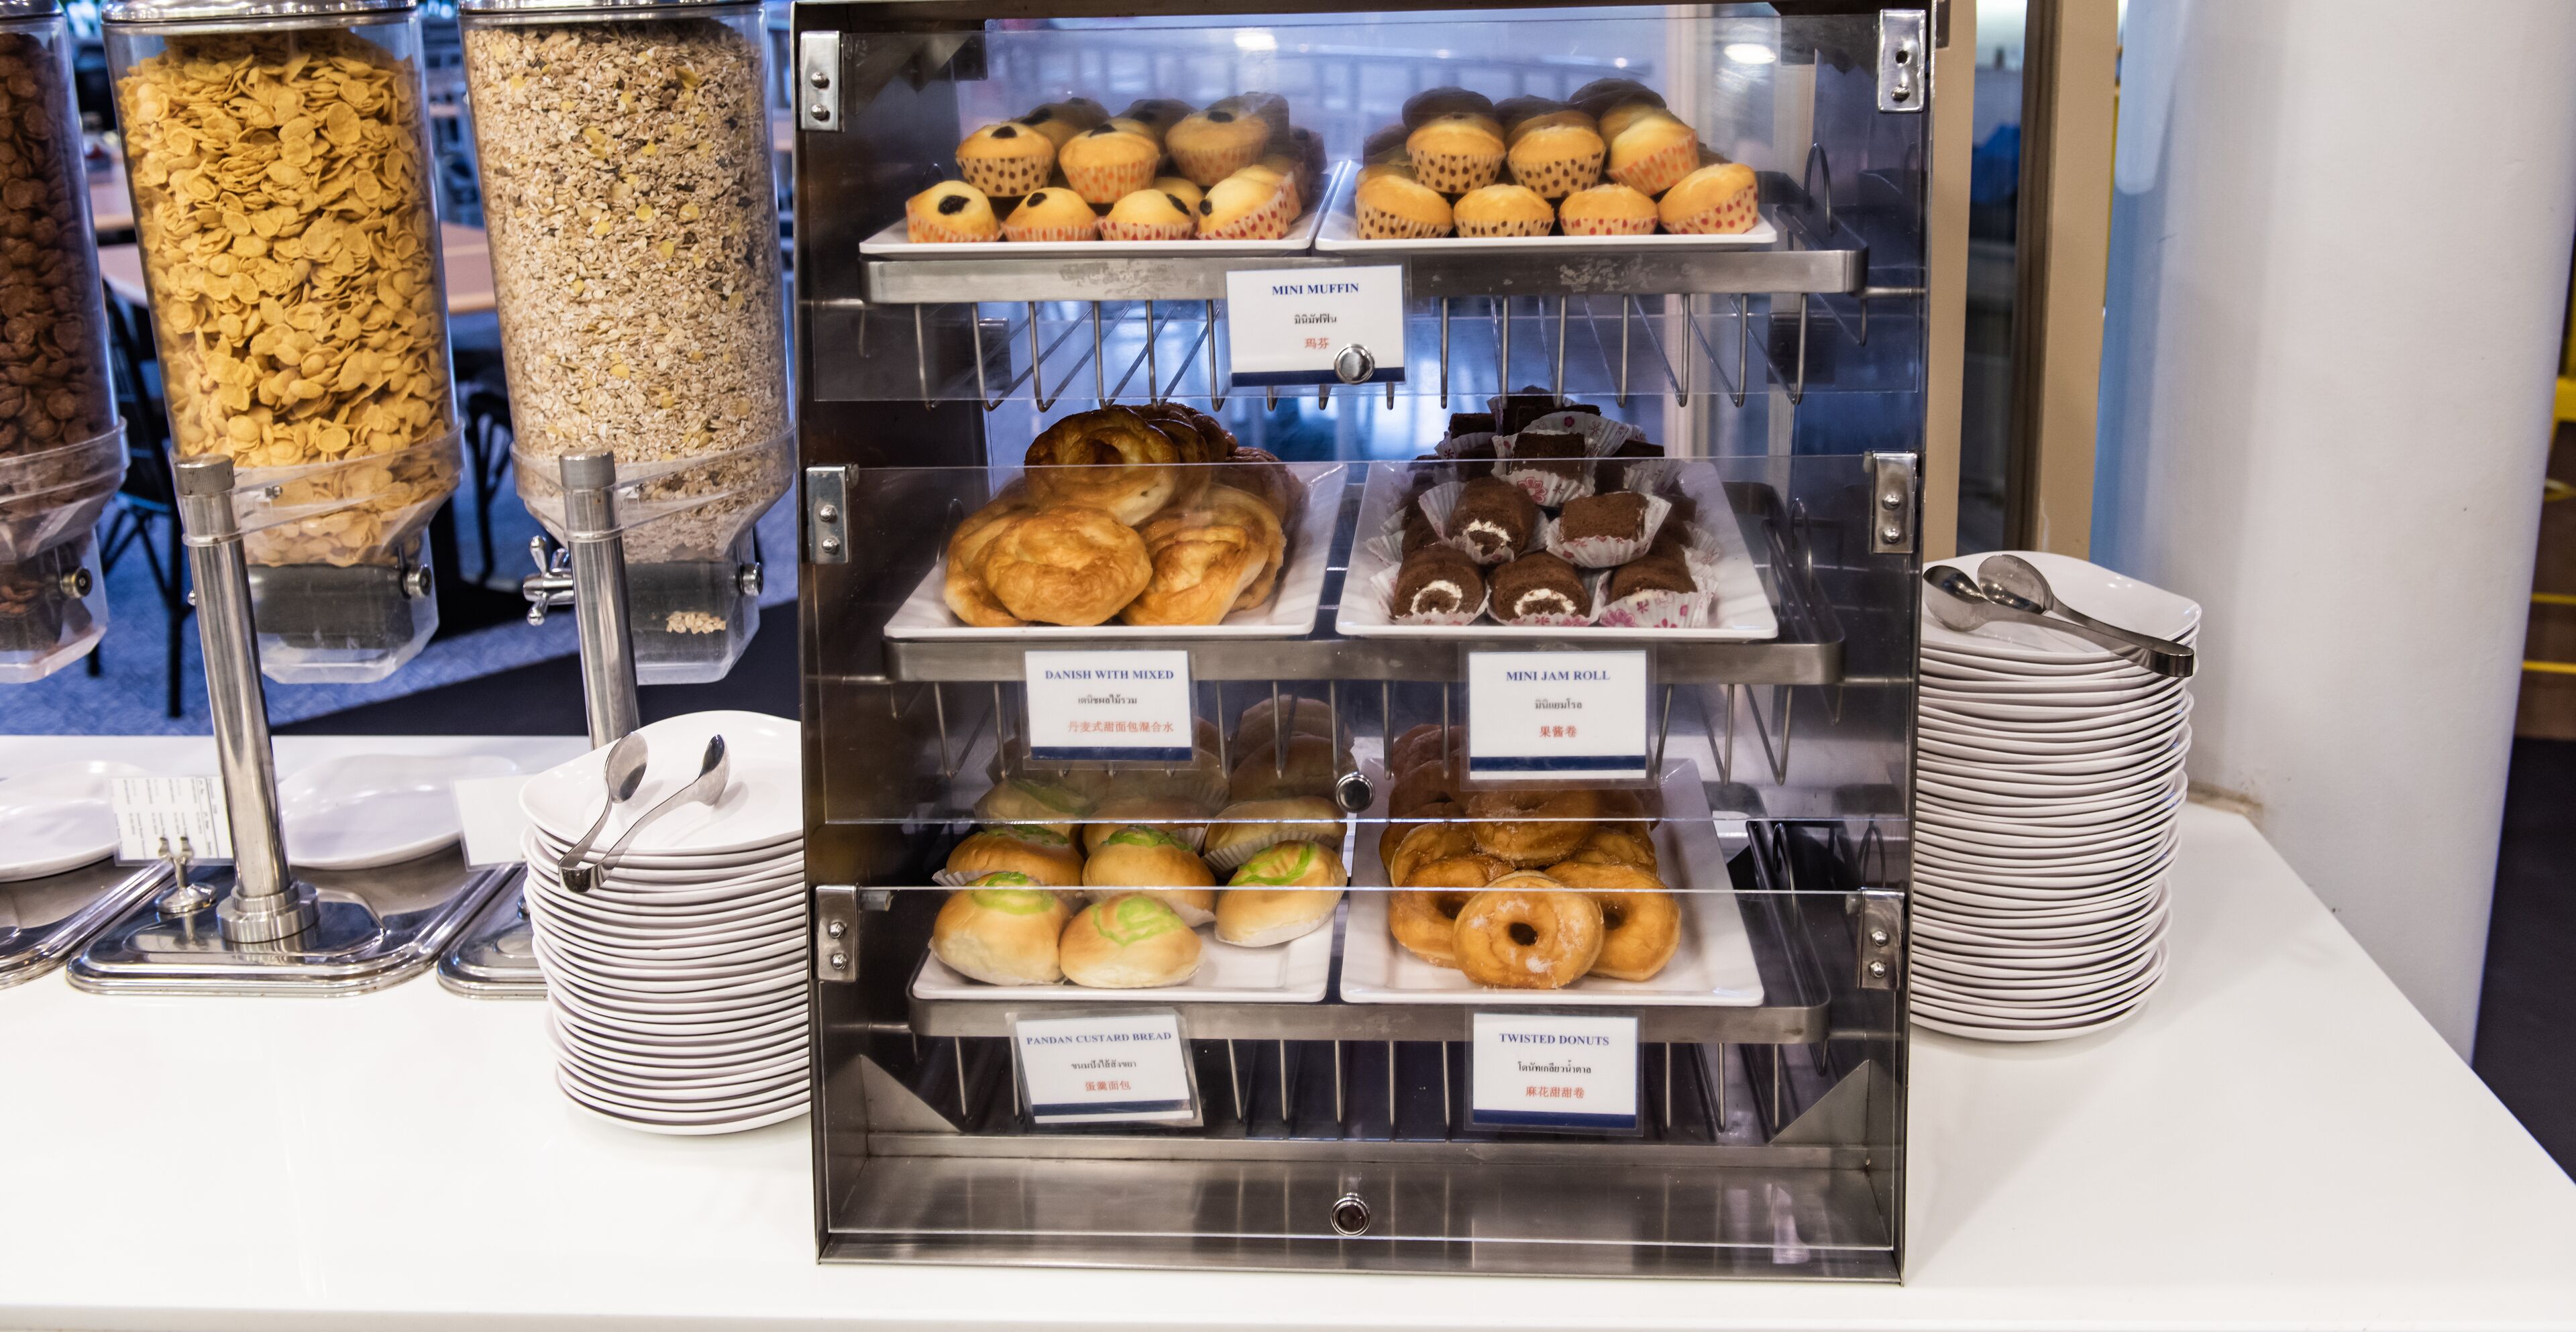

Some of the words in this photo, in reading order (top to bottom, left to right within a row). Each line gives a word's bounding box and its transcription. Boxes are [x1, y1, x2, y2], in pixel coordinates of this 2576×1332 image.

[1272, 284, 1303, 296] MINI
[1307, 282, 1359, 295] MUFFIN
[1304, 337, 1330, 349] 玛芬
[1045, 670, 1091, 679] DANISH
[1094, 670, 1129, 679] WITH
[1132, 670, 1174, 679] MIXED
[1506, 671, 1538, 681] MINI
[1540, 671, 1570, 681] JAM
[1573, 670, 1611, 681] ROLL
[1540, 725, 1577, 738] 果酱卷
[1026, 1036, 1073, 1045] PANDAN
[1075, 1034, 1130, 1044] CUSTARD
[1132, 1032, 1172, 1042] BREAD
[1499, 1033, 1556, 1044] TWISTED
[1559, 1035, 1609, 1046] DONUTS
[1525, 1085, 1585, 1099] 麻花甜甜卷
